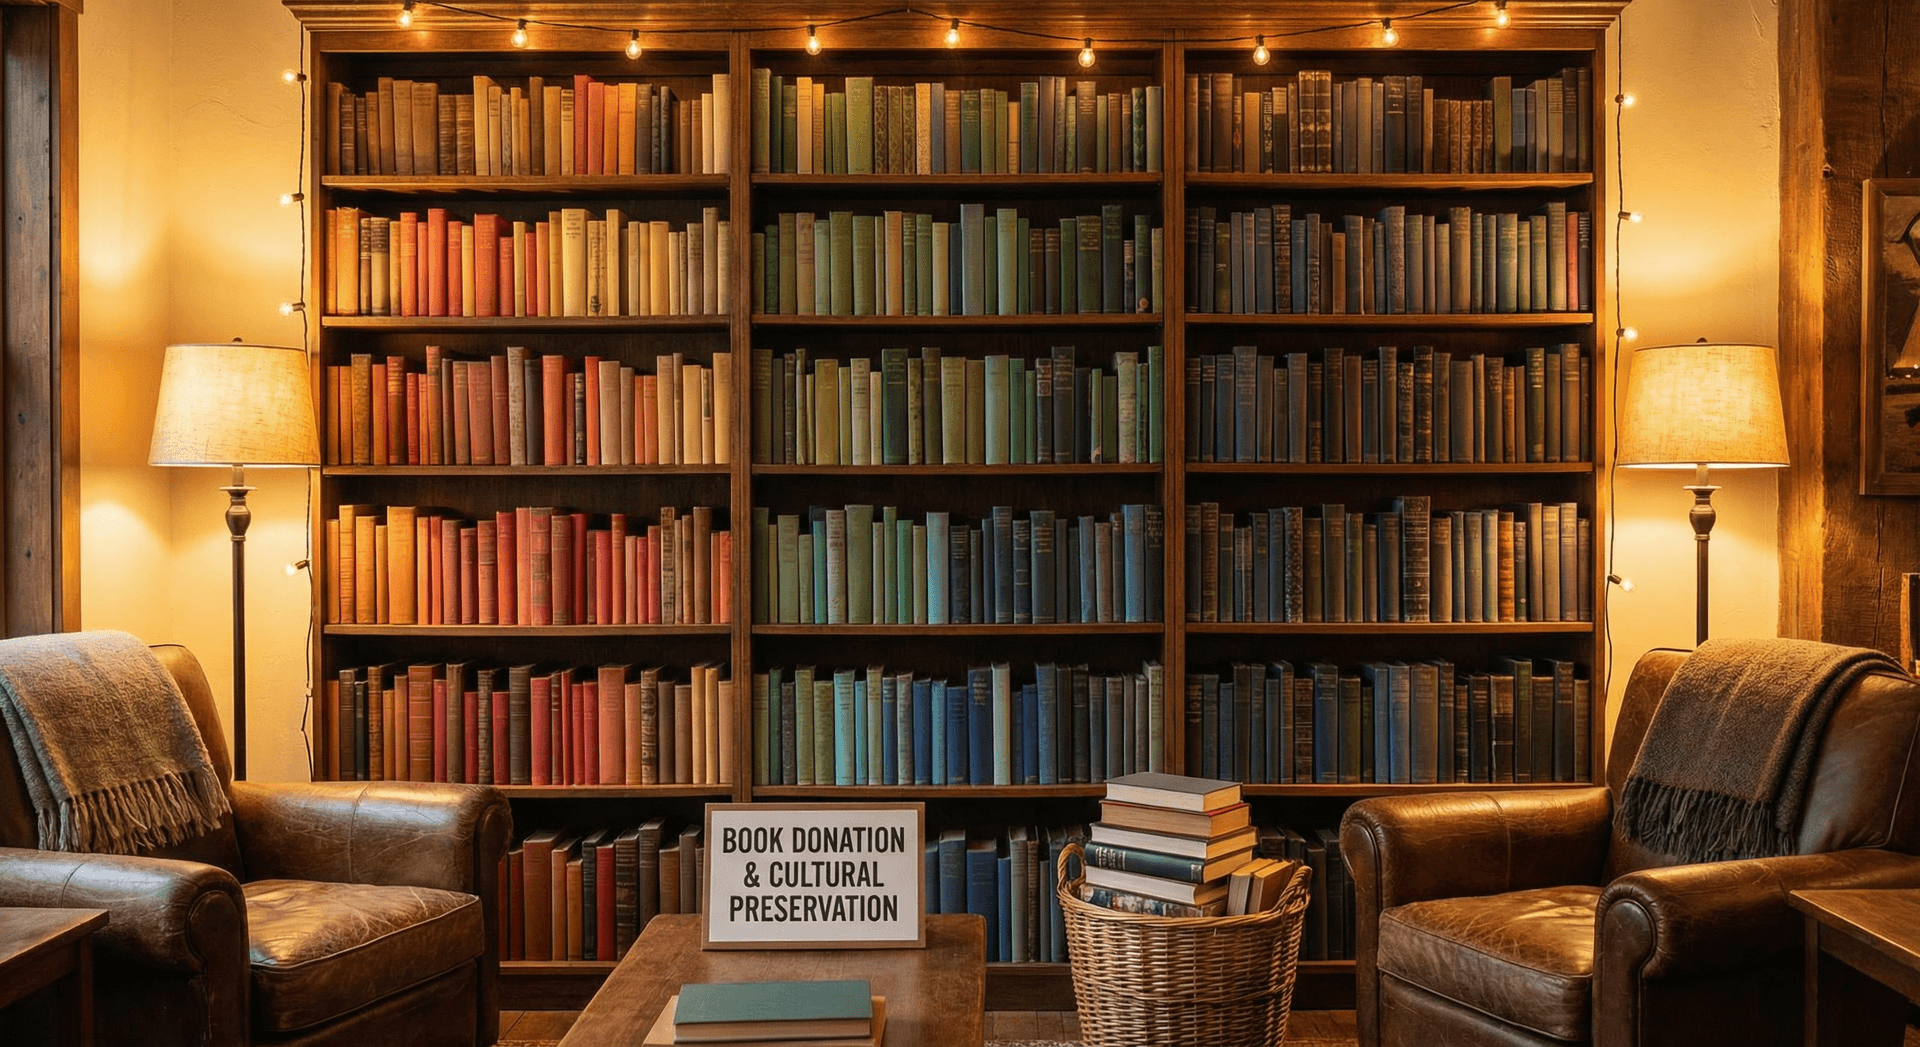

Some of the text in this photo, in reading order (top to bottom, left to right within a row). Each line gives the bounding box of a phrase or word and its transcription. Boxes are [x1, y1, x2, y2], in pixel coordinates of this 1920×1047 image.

[723, 827, 904, 853] BOOK DONATION
[744, 861, 884, 887] & CULTURAL
[730, 895, 897, 922] PRESERVATION
